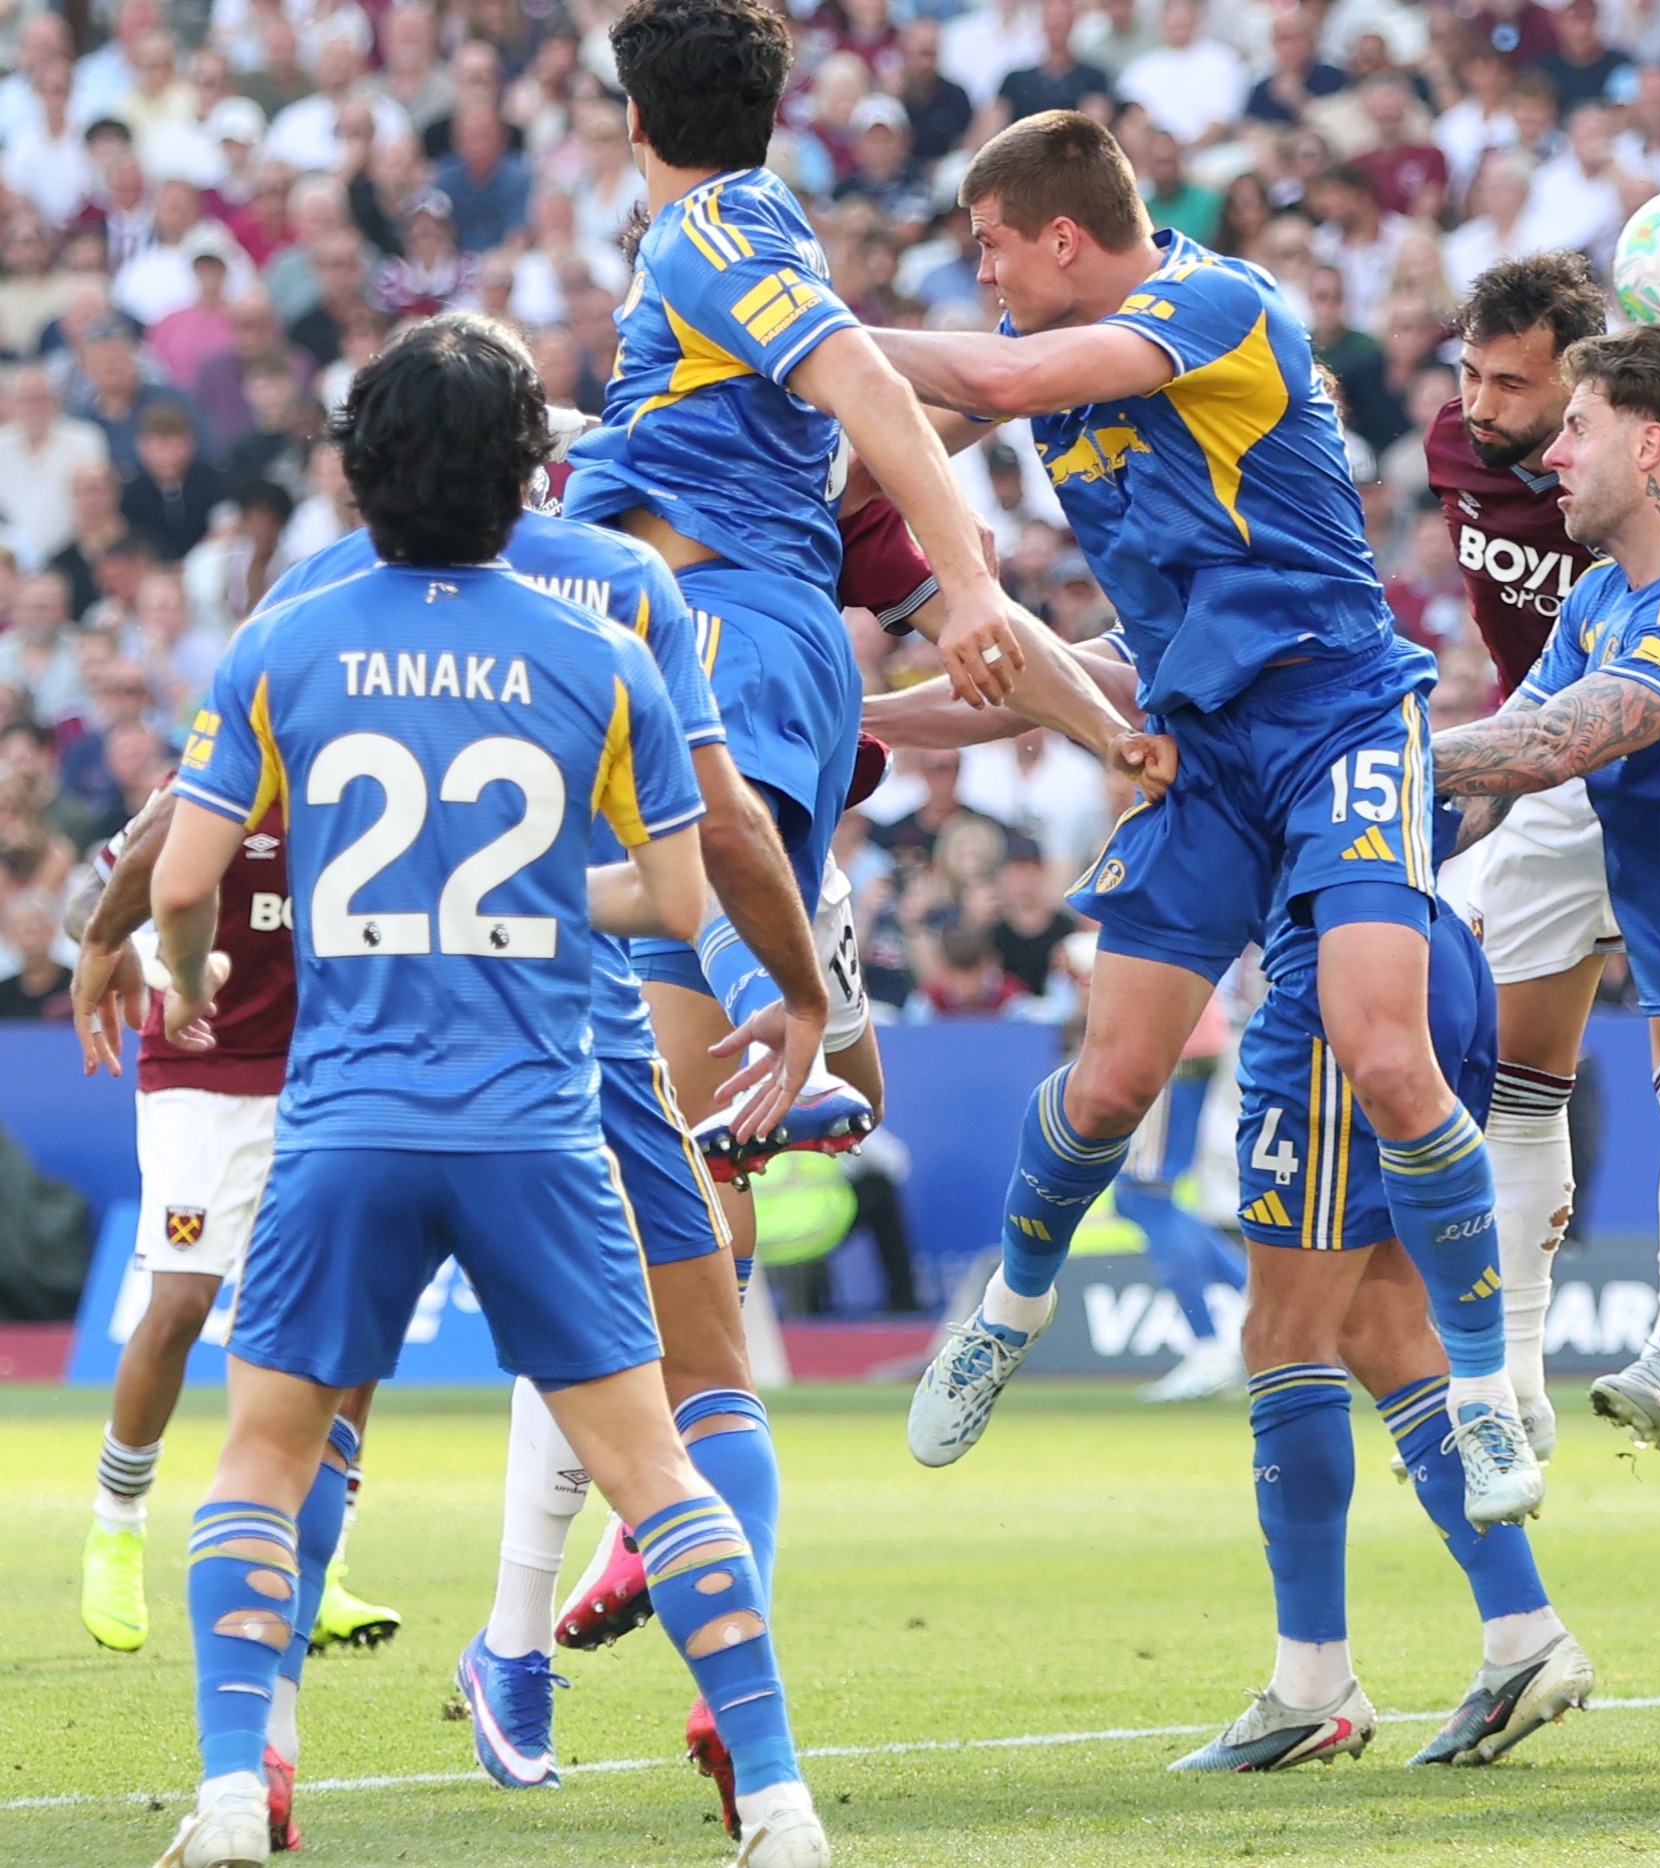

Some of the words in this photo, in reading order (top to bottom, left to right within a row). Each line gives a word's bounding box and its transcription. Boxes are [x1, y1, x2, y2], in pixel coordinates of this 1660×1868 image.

[516, 573, 610, 617] WIN
[340, 651, 532, 704] TANAKA
[1330, 749, 1401, 824] 15
[306, 731, 566, 960] 22
[1250, 1107, 1299, 1186] 4
